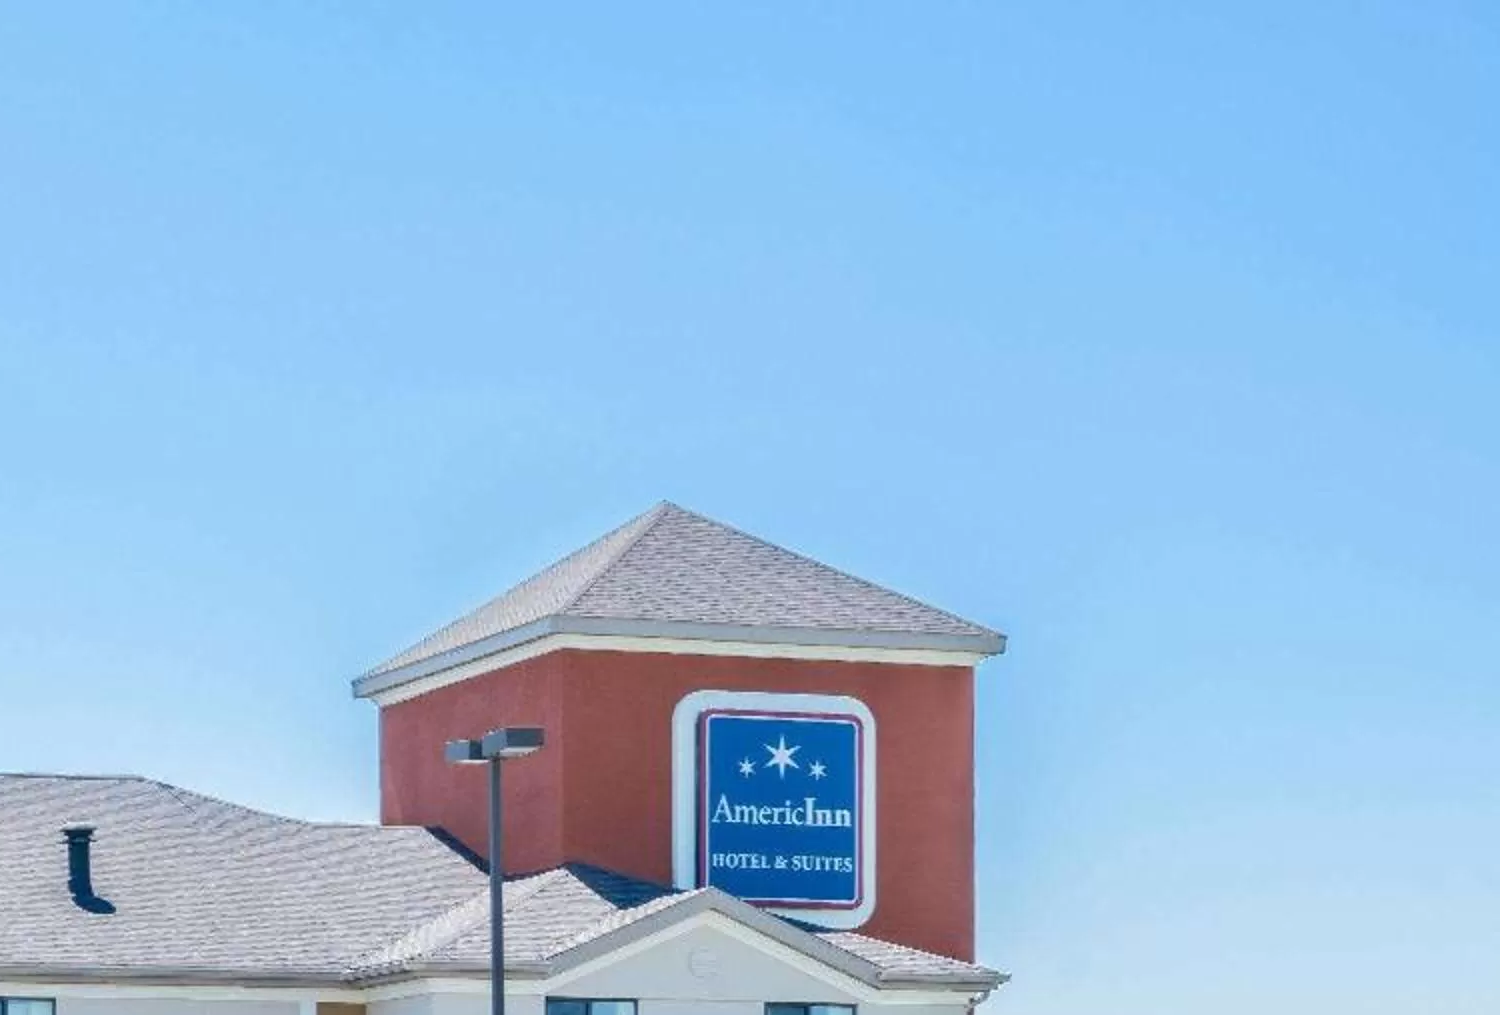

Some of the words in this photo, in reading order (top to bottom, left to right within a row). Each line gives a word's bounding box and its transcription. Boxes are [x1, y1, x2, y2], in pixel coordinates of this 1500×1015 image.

[711, 793, 852, 827] AmericInn
[712, 853, 770, 869] HOTEL
[775, 855, 788, 869] &
[791, 856, 852, 872] SUITES
